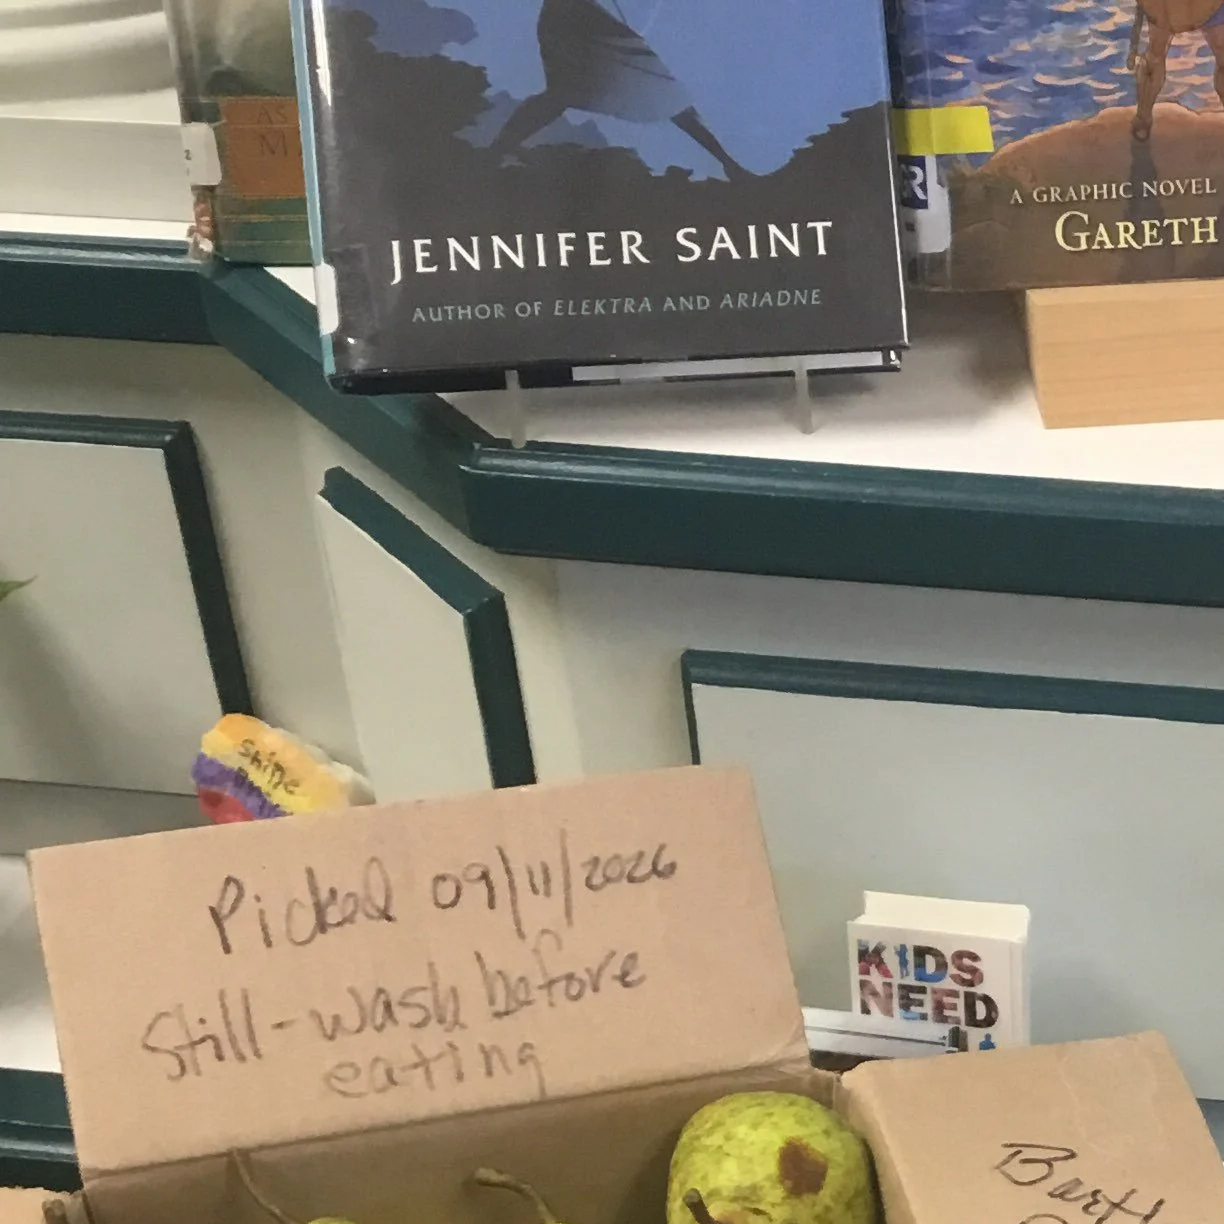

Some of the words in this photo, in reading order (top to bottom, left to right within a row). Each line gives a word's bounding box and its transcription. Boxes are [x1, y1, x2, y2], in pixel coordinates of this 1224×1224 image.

[1010, 189, 1024, 205] A
[1032, 181, 1133, 204] GRAPHIC
[1142, 177, 1217, 197] NOVEL
[391, 231, 650, 285] JENNIFER
[676, 221, 832, 262] SAINT
[1054, 210, 1218, 253] GARETH
[412, 303, 506, 322] AUTHOR
[515, 301, 543, 318] OF
[553, 297, 652, 316] ELEKTRA
[663, 295, 710, 311] AND
[720, 288, 822, 308] ARIADNE
[431, 828, 678, 941] 09/11/2026
[474, 928, 646, 1021] before
[857, 938, 984, 988] KIDS
[859, 978, 999, 1029] NEED
[323, 1037, 546, 1099] eating
